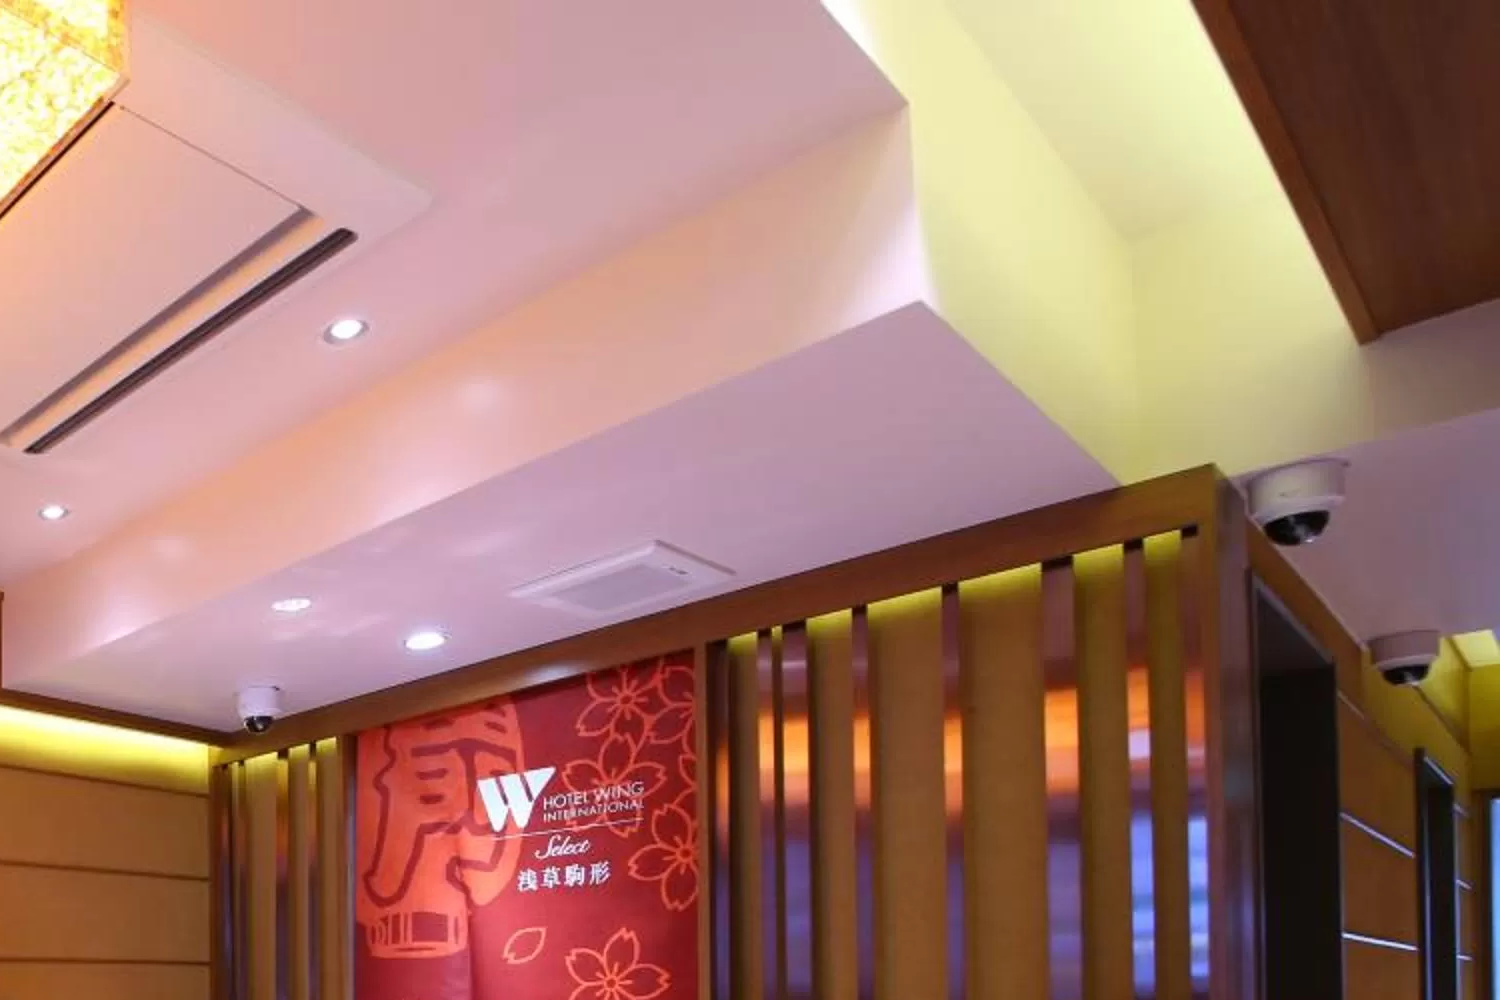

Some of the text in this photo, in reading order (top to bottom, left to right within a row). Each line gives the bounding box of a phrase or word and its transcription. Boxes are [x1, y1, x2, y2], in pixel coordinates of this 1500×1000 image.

[476, 766, 556, 833] W
[543, 781, 644, 811] HOTEL WING
[543, 799, 645, 822] INTERNATIONAL
[534, 834, 591, 861] Select
[518, 861, 611, 892] 浅草駒形
